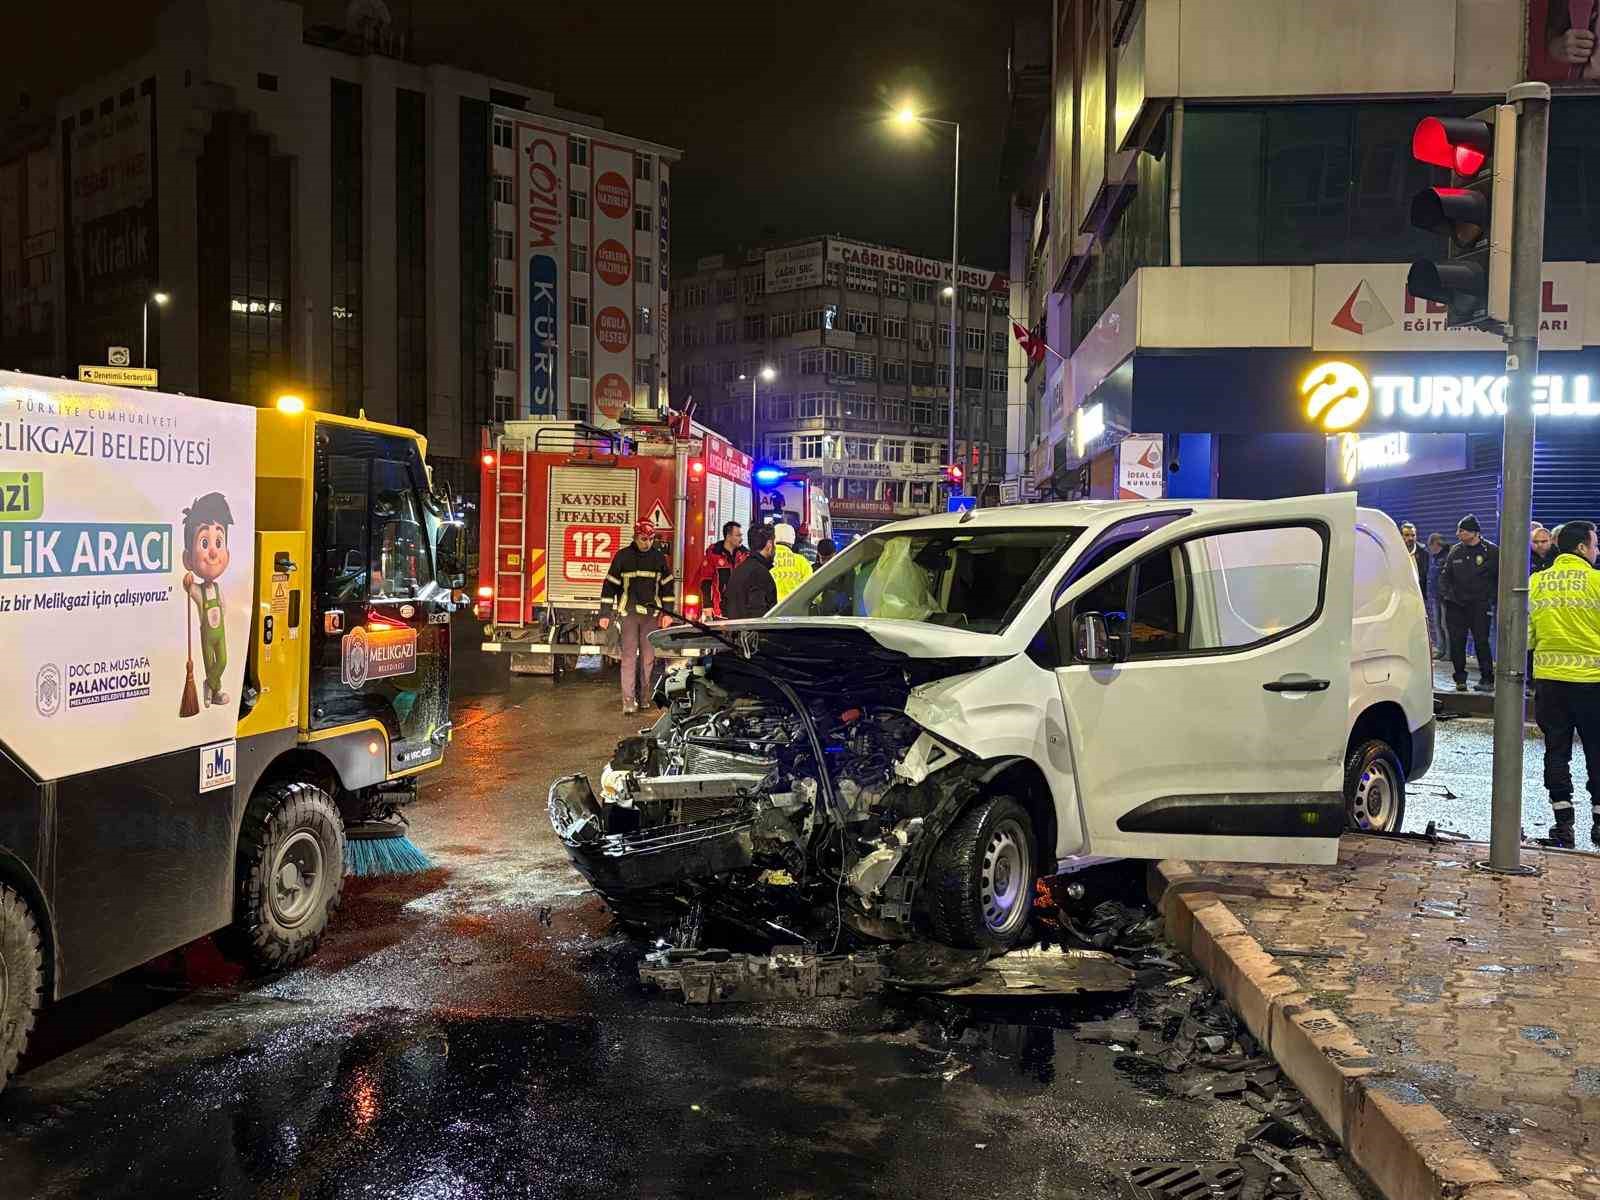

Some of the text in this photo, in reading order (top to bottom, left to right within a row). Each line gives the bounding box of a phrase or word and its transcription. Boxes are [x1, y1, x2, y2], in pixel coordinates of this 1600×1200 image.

[525, 138, 563, 248] ÇÖZÜM
[842, 247, 884, 270] ÇAĞRI
[887, 255, 941, 278] SÜRÜCÜ
[534, 281, 555, 405] KURS
[102, 432, 211, 466] BELEDİYESİ
[561, 493, 627, 506] KAYSERİ
[556, 507, 630, 524] İTFAİYESİ
[71, 530, 170, 573] ARACI
[572, 532, 611, 558] 112
[14, 594, 32, 611] bir
[33, 590, 91, 611] Melikgazi
[92, 590, 112, 609] için
[110, 656, 151, 672] MUSTAFA
[69, 671, 150, 696] PALANCIOĞLU
